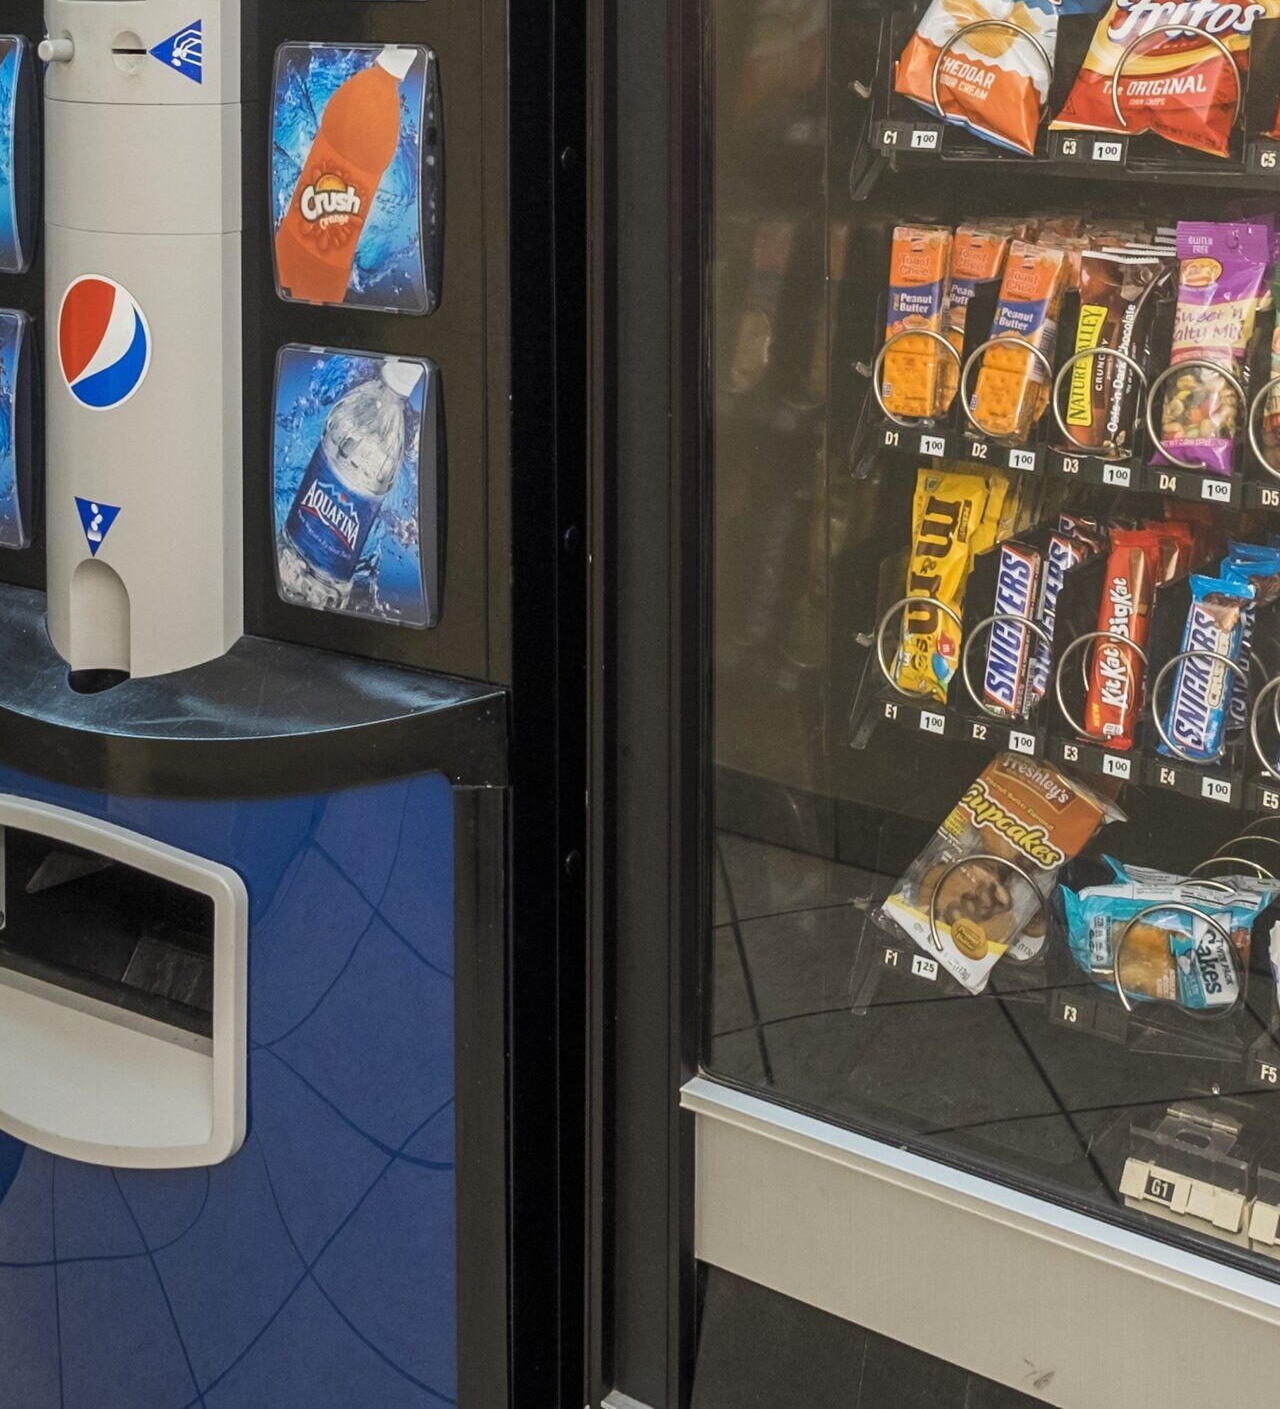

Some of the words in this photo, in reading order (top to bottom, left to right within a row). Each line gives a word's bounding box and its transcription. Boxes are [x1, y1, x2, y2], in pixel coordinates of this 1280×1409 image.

[1126, 73, 1207, 96] ORIGINAL
[882, 129, 898, 146] C1
[1061, 139, 1077, 157] C3
[1259, 151, 1277, 169] C5
[300, 185, 361, 220] Crush
[900, 292, 933, 305] Peanut
[899, 303, 929, 314] Butter
[1001, 306, 1034, 322] Peanut
[998, 316, 1029, 331] Butter
[884, 431, 900, 447] D1
[971, 442, 988, 459] D2
[1062, 457, 1080, 474] D3
[1158, 474, 1178, 492] D4
[1261, 490, 1280, 507] D5
[301, 478, 361, 550] AQUAFINA
[986, 552, 1031, 706] SNICKERS
[1174, 609, 1218, 747] SNICKERS
[884, 703, 899, 721] E1
[972, 723, 987, 741] E2
[1063, 744, 1079, 762] E3
[1001, 755, 1071, 804] Freshley's
[1159, 767, 1177, 786] E4
[1262, 791, 1280, 810] E5
[961, 783, 1061, 866] Cupcakes
[884, 948, 899, 966] F1
[1195, 929, 1224, 995] Cakes
[1063, 1004, 1077, 1023] F3
[1260, 1064, 1278, 1085] F5
[1149, 1178, 1171, 1200] G1
